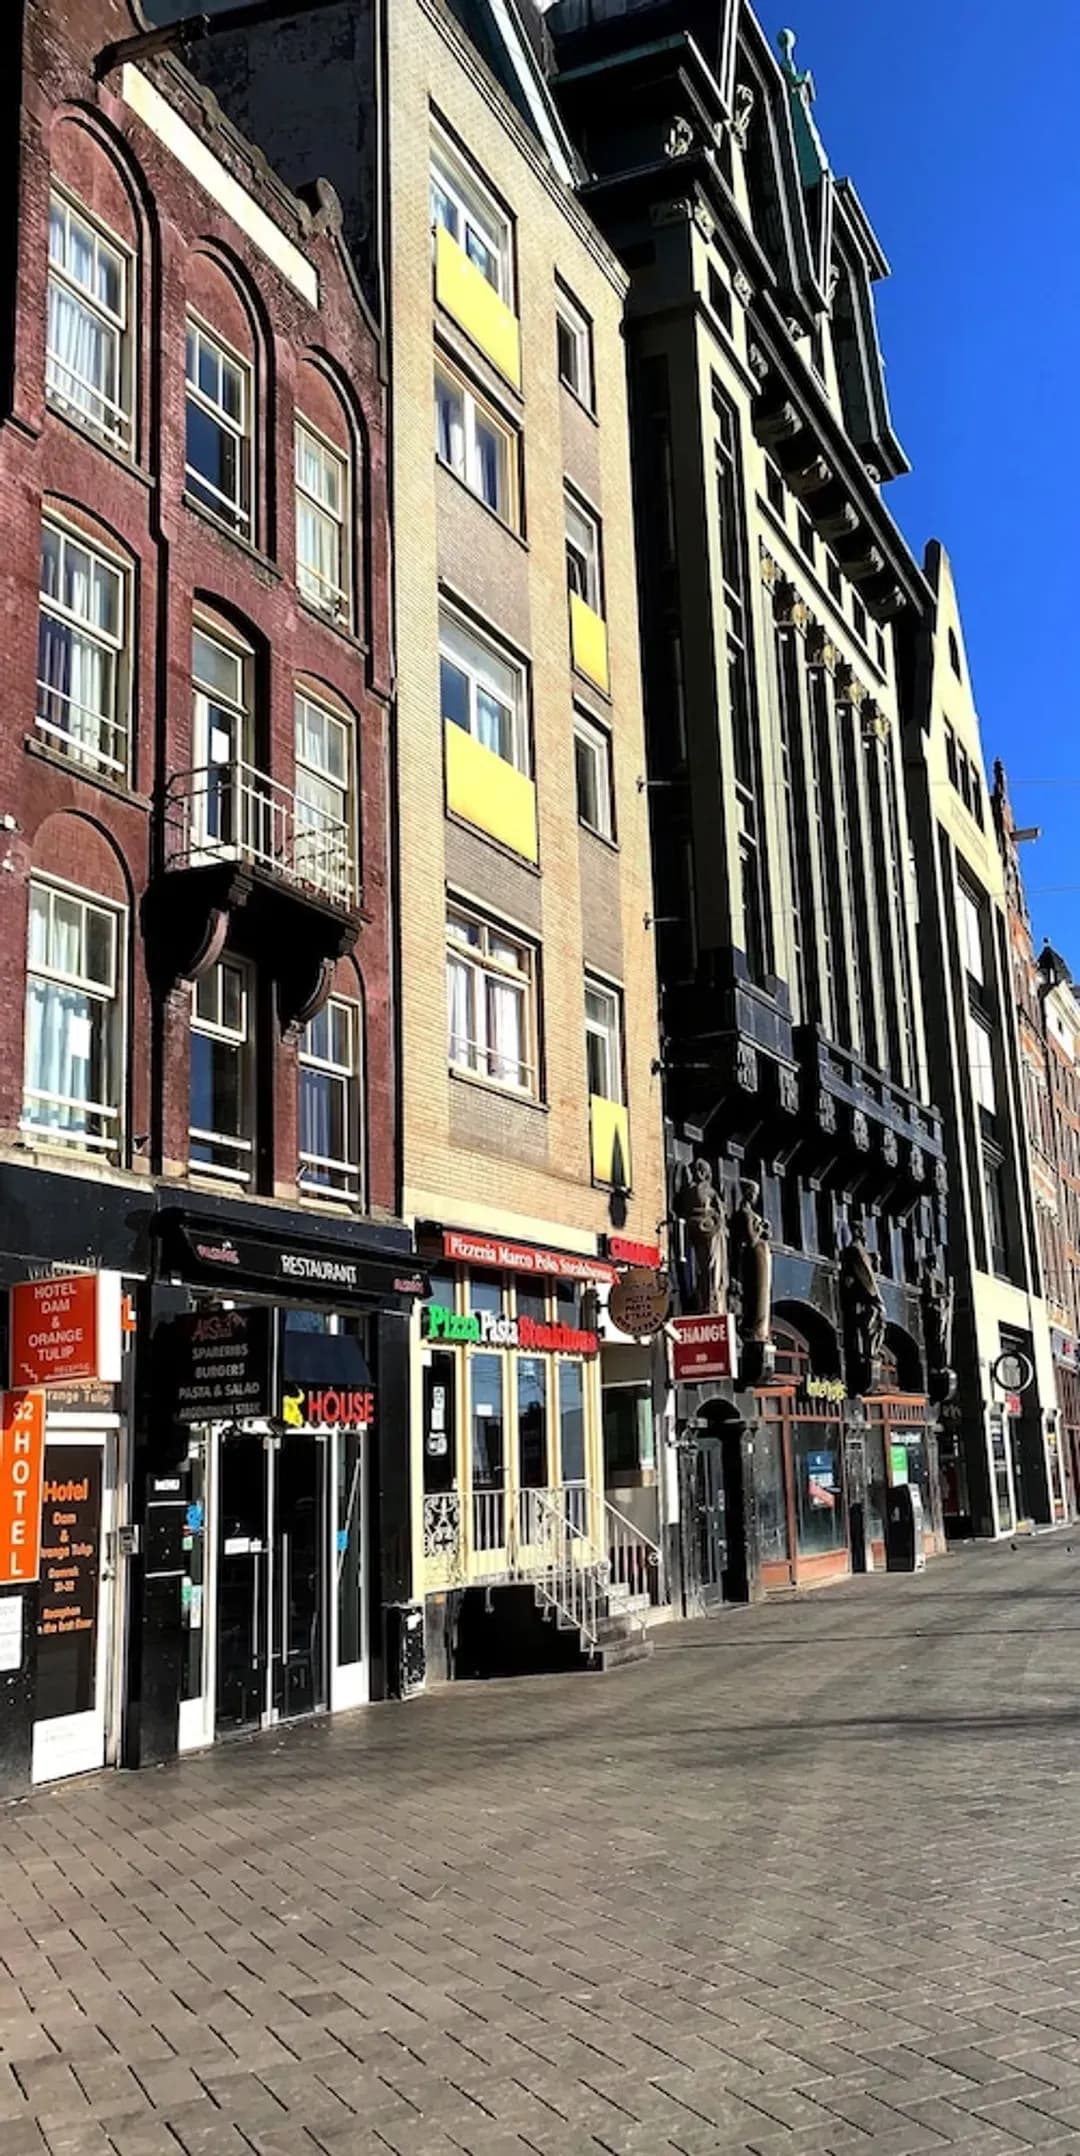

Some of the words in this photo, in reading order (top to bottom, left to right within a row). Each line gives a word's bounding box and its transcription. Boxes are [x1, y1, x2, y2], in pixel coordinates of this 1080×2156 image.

[451, 1237, 496, 1261] Pizzeria
[499, 1246, 533, 1268] Marco
[535, 1252, 558, 1272] Polo
[281, 1254, 357, 1284] RESTAURANT
[34, 1283, 77, 1299] HOTEL
[41, 1299, 70, 1313] DAM
[51, 1315, 60, 1329] &
[428, 1304, 480, 1342] Pizza
[480, 1309, 519, 1345] Pasta
[28, 1328, 84, 1347] ORANGE
[37, 1347, 74, 1361] TULIP
[191, 1343, 249, 1360] SPARERIBS
[195, 1362, 245, 1379] BURGERS
[47, 1390, 79, 1405] range
[85, 1389, 111, 1405] Tulip
[178, 1385, 212, 1400] PASTA
[213, 1384, 223, 1398] &
[224, 1381, 260, 1396] SALAD
[13, 1401, 34, 1421] 32
[308, 1390, 374, 1424] HOUSE
[43, 1478, 88, 1502] Hotel
[9, 1430, 31, 1577] HOTEL
[53, 1511, 77, 1526] Dam
